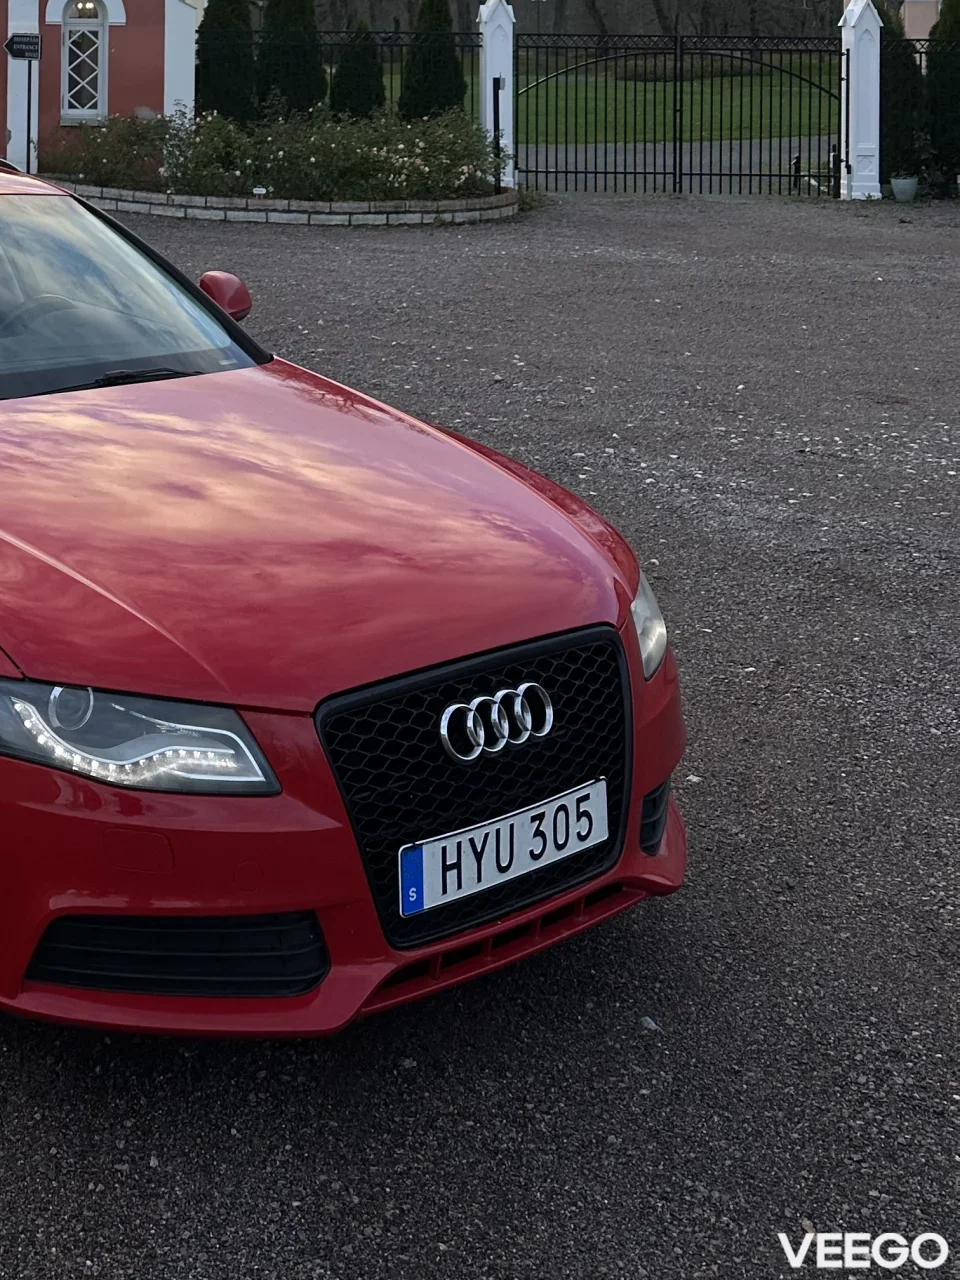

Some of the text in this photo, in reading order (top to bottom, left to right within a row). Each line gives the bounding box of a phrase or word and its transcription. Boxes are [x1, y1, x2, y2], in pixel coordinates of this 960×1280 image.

[441, 792, 594, 896] HYU 305
[409, 887, 417, 902] S
